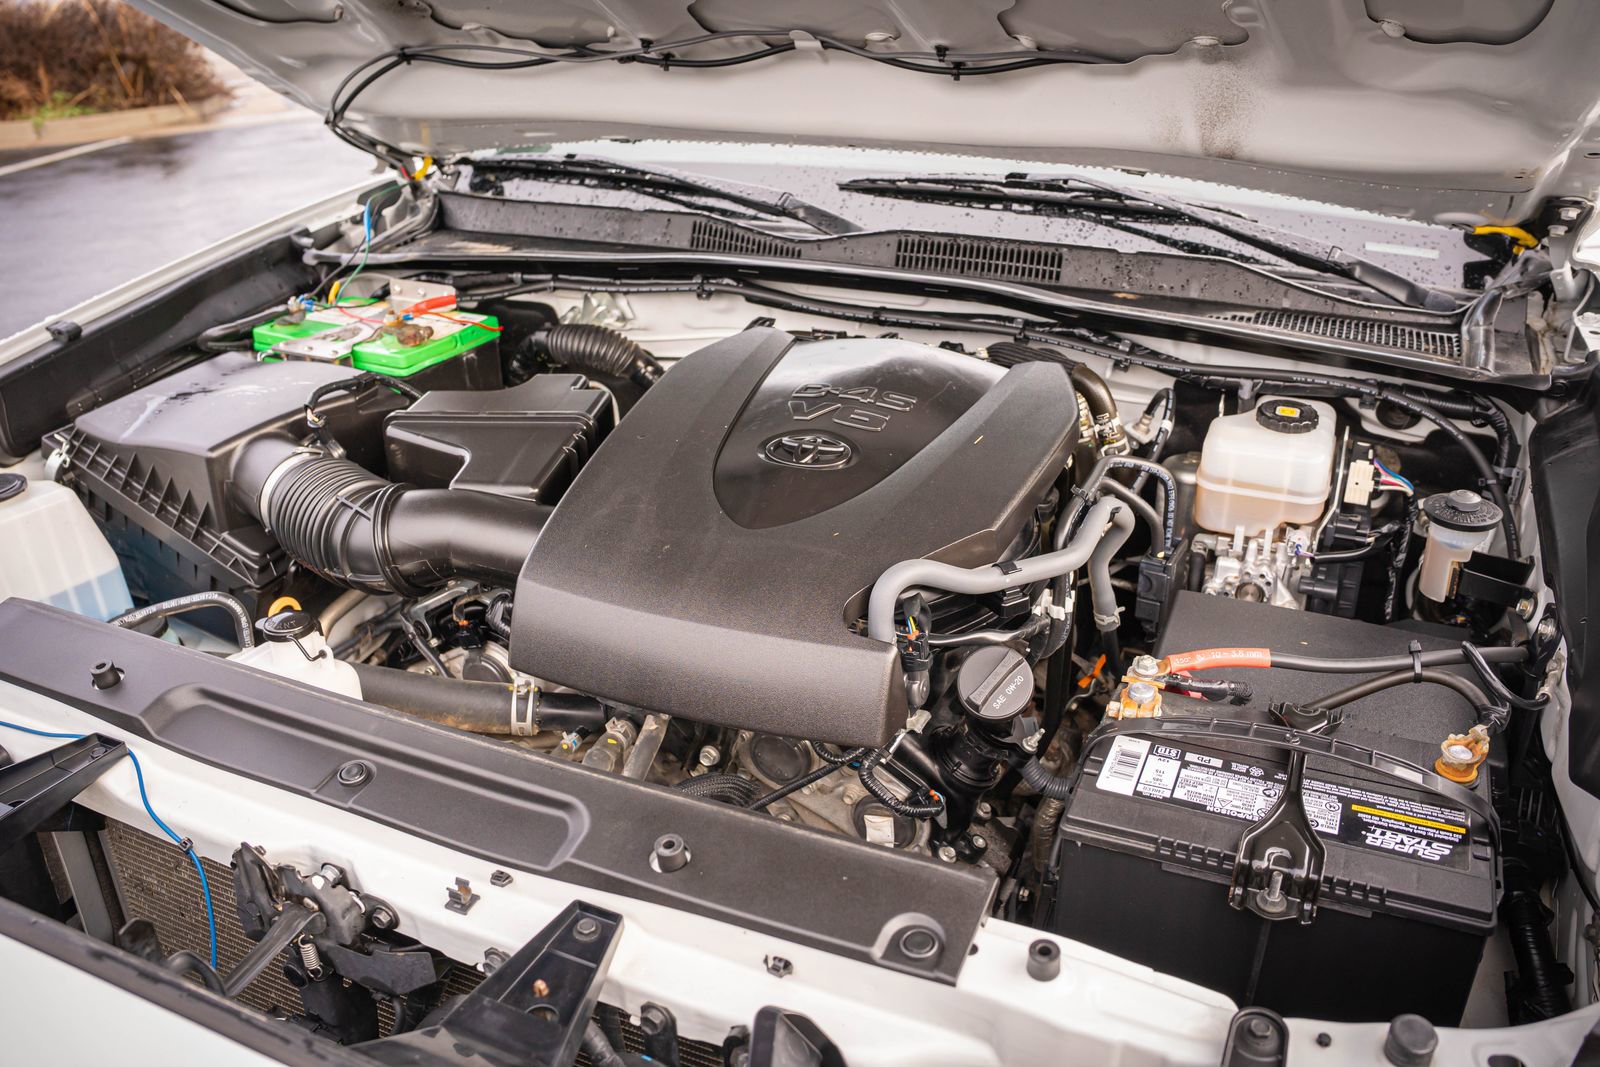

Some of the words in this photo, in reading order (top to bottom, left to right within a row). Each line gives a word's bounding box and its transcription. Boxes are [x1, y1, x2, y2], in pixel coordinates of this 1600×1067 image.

[788, 400, 891, 431] V6
[992, 694, 1006, 709] SAE
[1005, 675, 1024, 695] 0W-20
[1157, 746, 1177, 756] STD
[1196, 755, 1211, 764] Pb
[1205, 804, 1261, 821] ER/POISON
[1365, 827, 1453, 856] START
[1365, 837, 1441, 861] SUPER
